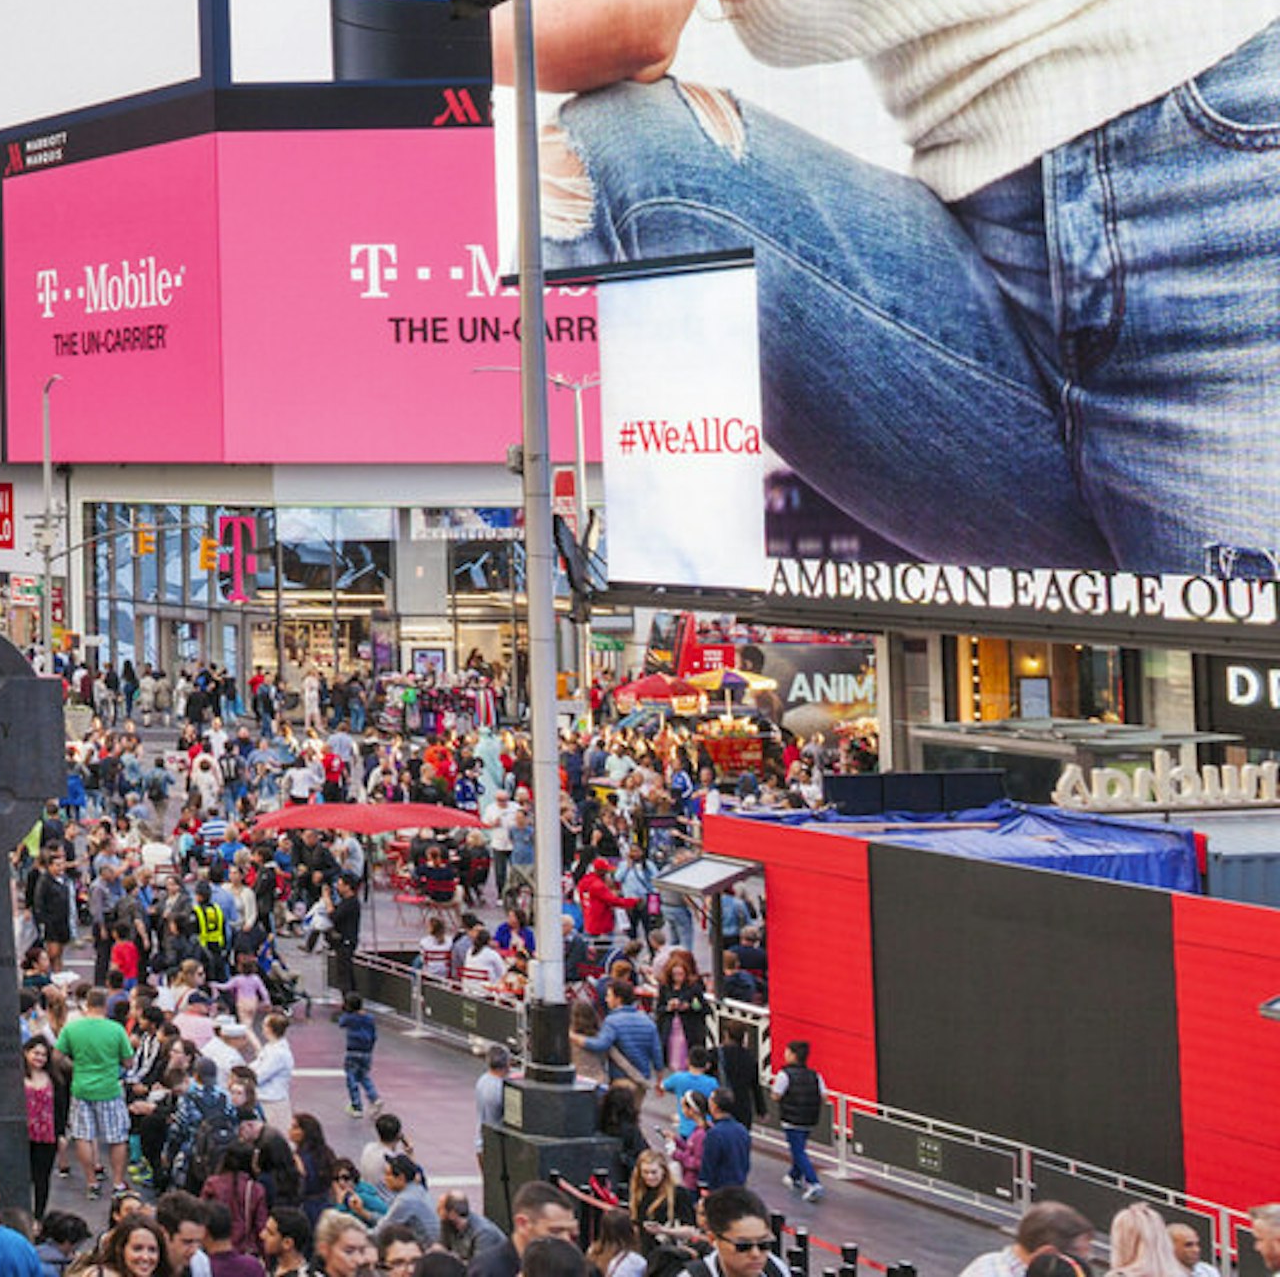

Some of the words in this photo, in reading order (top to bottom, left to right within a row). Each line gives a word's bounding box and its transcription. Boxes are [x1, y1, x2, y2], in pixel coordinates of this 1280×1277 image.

[54, 331, 80, 357] THE
[81, 323, 167, 356] UN-CARRIER
[389, 317, 449, 344] THE
[618, 416, 762, 455] #WeAllCa
[767, 558, 991, 605] AMERICAN
[1013, 568, 1167, 619] EAGLE
